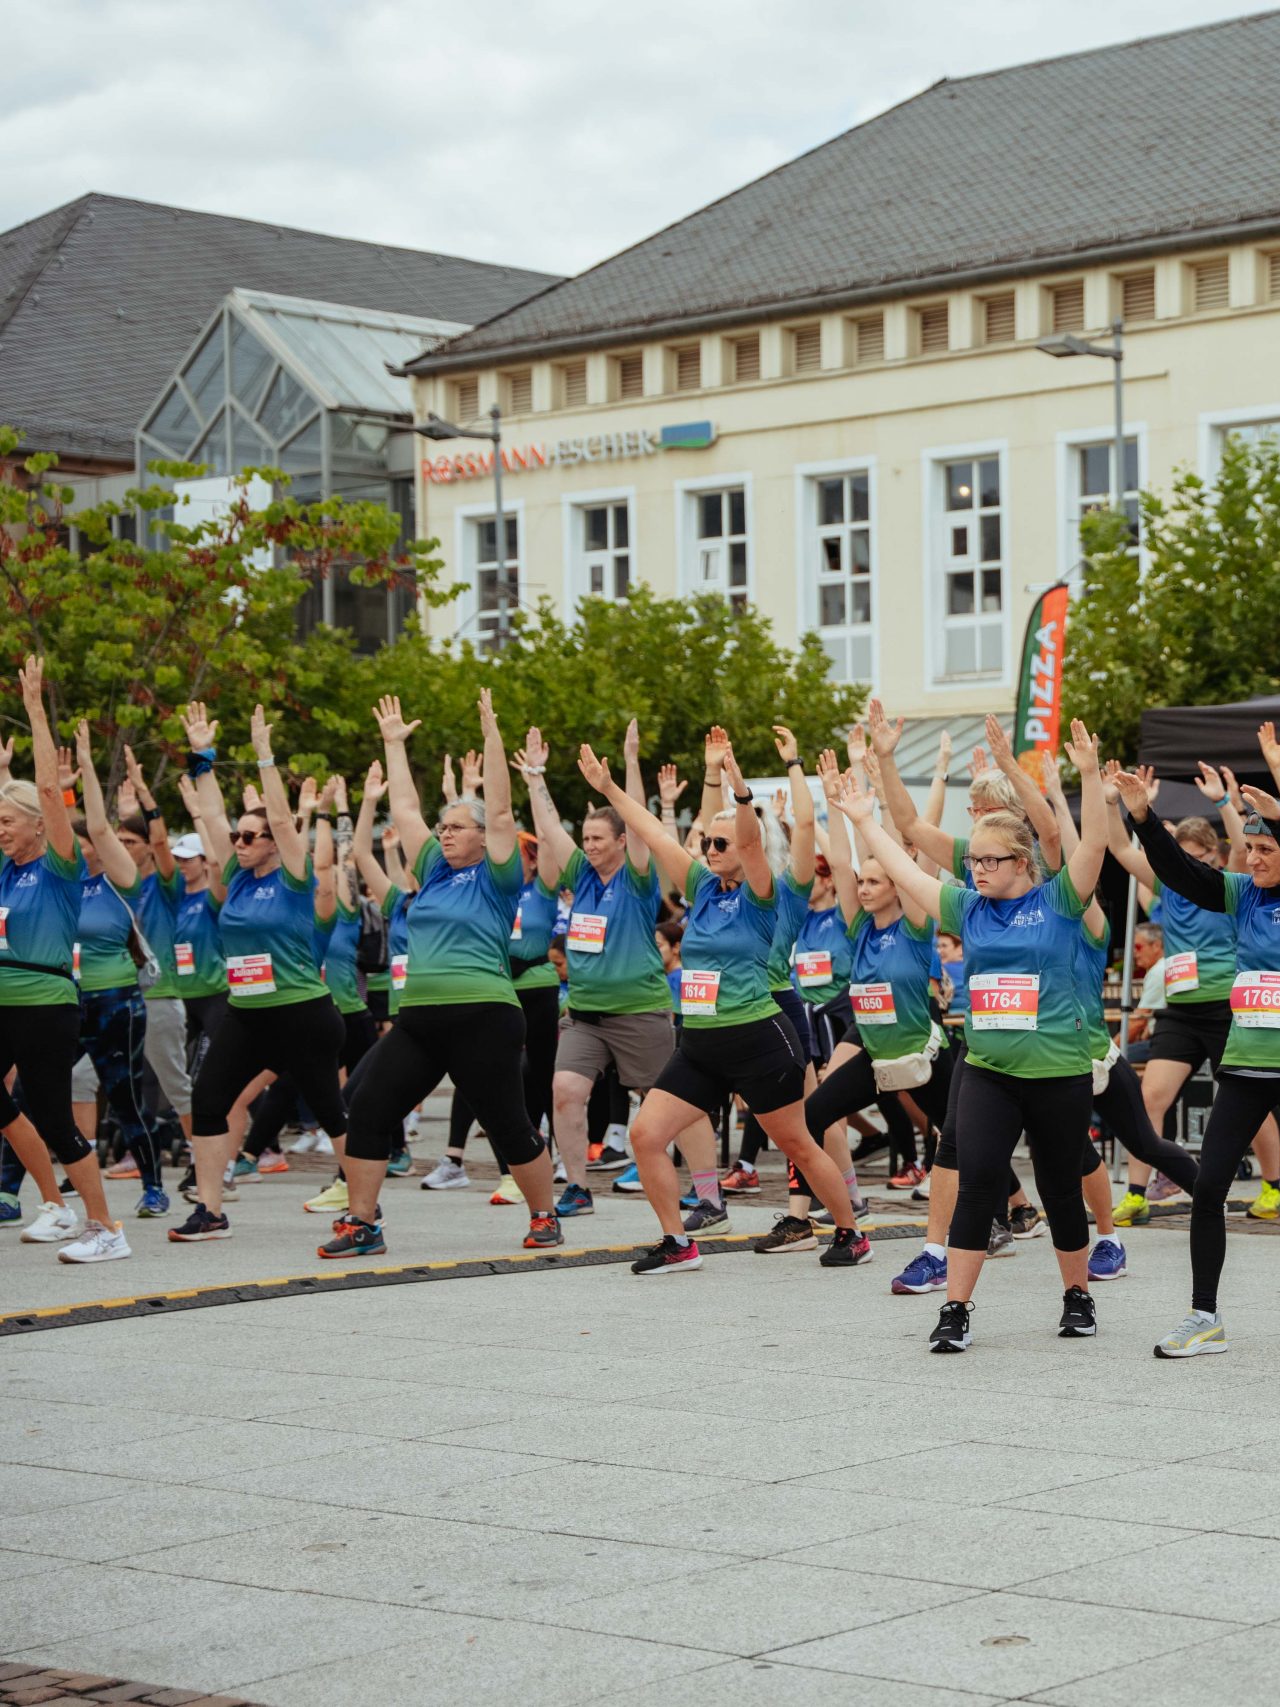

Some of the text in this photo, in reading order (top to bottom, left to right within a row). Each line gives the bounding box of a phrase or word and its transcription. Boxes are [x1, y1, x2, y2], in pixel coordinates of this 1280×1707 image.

[1024, 621, 1058, 742] PIZZA
[685, 984, 707, 999] 1614
[858, 997, 883, 1011] 1650
[982, 991, 1022, 1009] 1764
